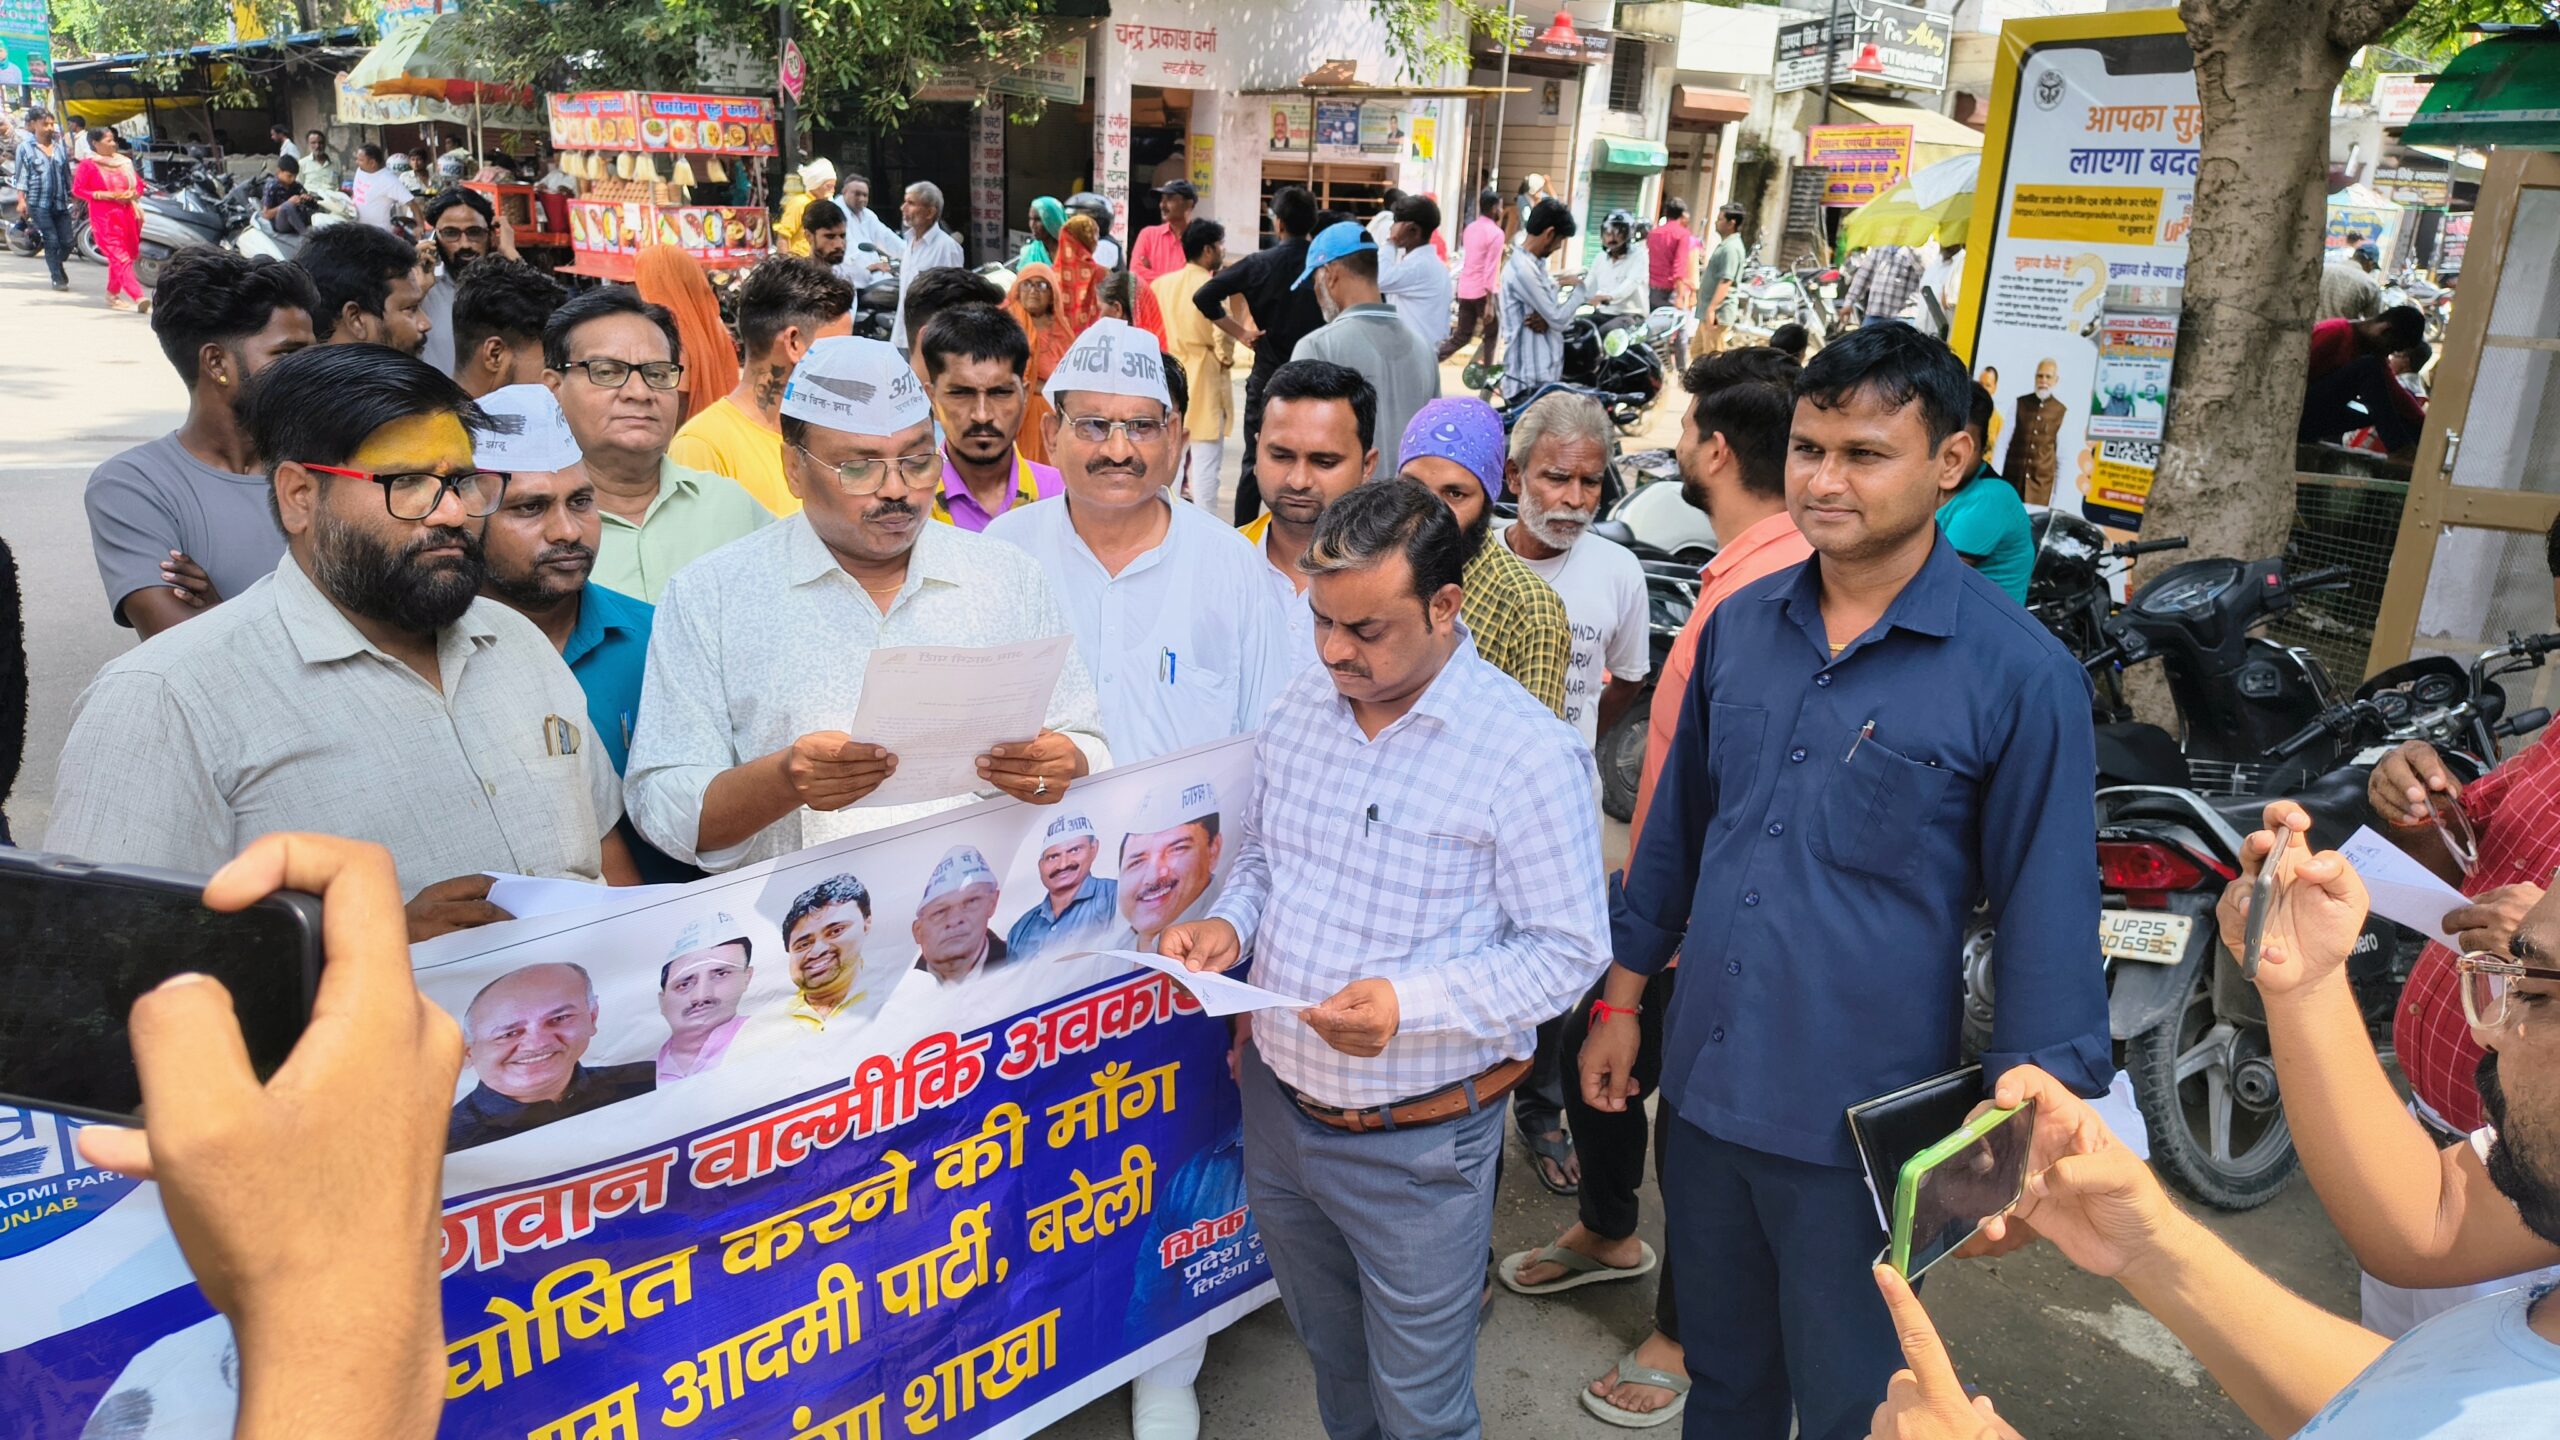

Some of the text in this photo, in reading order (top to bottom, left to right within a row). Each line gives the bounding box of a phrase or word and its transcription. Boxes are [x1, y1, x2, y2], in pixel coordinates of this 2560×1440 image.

[1115, 23, 1218, 53] चन्द्र प्रकाश वर्मा
[2085, 105, 2167, 133] आपका
[2070, 148, 2145, 175] लाएगा
[2109, 262, 2139, 279] सुझाव
[2141, 261, 2151, 277] से
[2152, 264, 2174, 278] क्या
[1073, 334, 1160, 384] पार्टी आम
[2112, 918, 2167, 936] UP25
[440, 1150, 677, 1272] गवान
[691, 1029, 991, 1188] वाल्मीकि
[720, 1149, 917, 1275] करने
[933, 1101, 1030, 1191] की
[1046, 1060, 1181, 1150] माँग
[66, 1170, 124, 1191] PAR
[1159, 1204, 1250, 1269] विवेक
[1184, 1240, 1243, 1284] प्रदेश
[1192, 1258, 1251, 1297] तिरंगा
[660, 1261, 864, 1428] आदमी
[877, 1201, 1009, 1317] पार्टी,
[1027, 1143, 1157, 1254] बरेली
[904, 1308, 1061, 1435] शाखा
